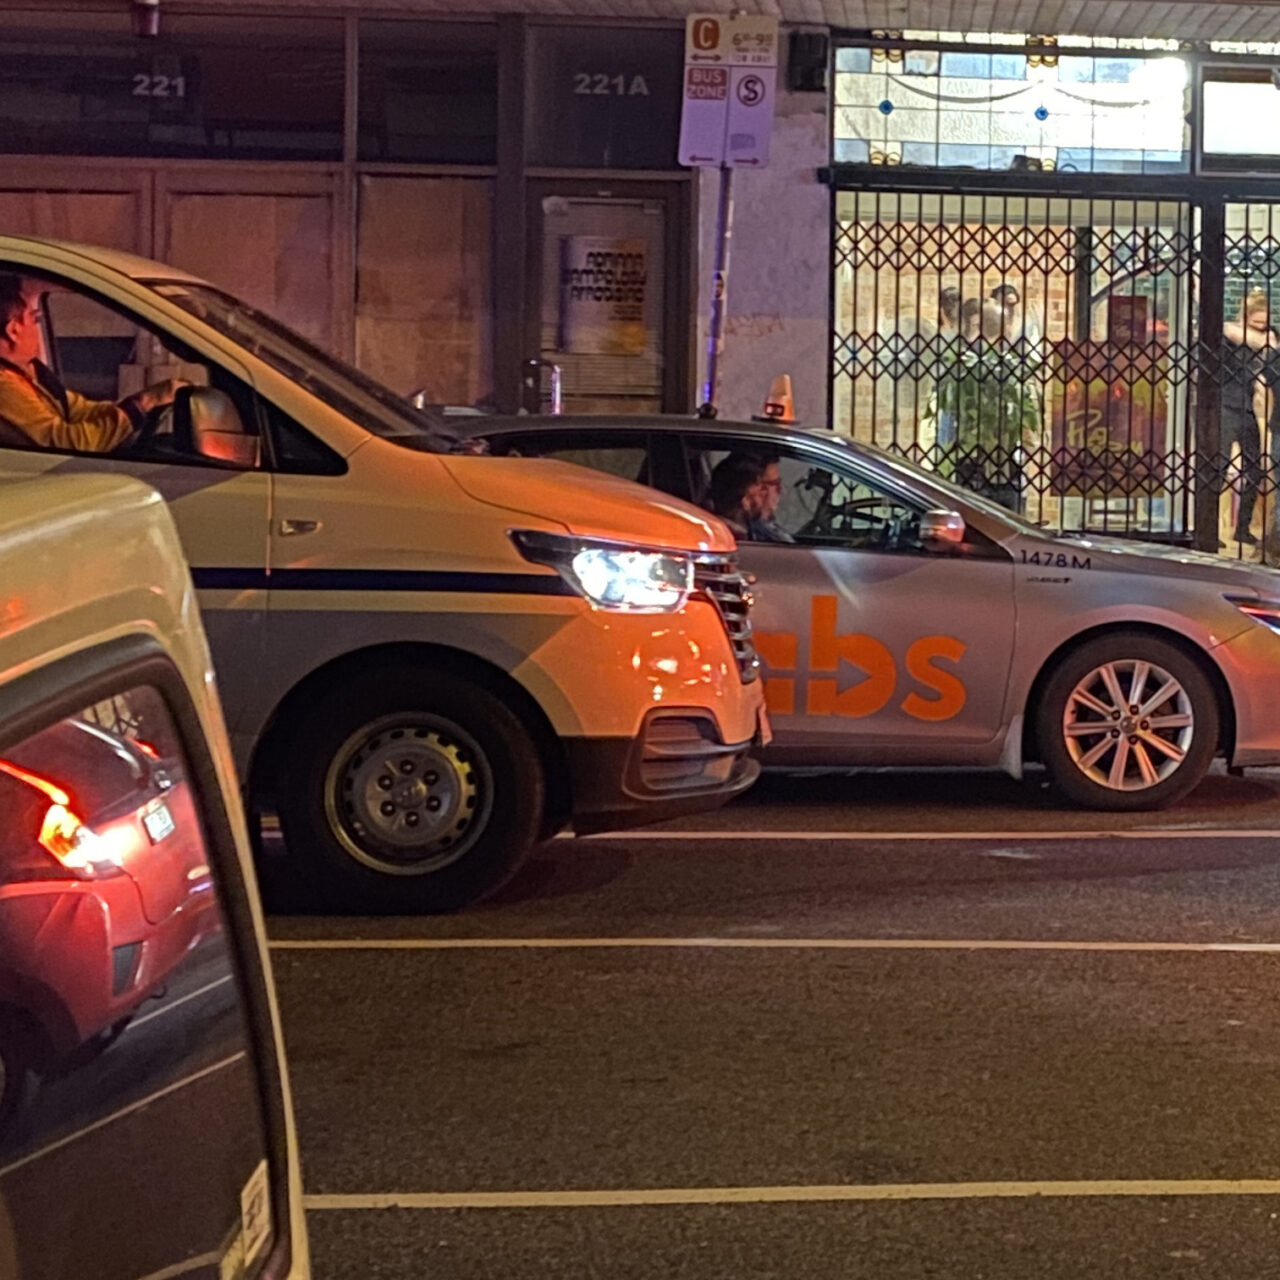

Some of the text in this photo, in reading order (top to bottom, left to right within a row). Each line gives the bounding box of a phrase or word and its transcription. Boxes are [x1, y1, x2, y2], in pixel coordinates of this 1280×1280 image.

[573, 73, 650, 97] 221A
[692, 70, 722, 83] BUS
[132, 74, 187, 98] 221
[688, 85, 726, 98] ZONE
